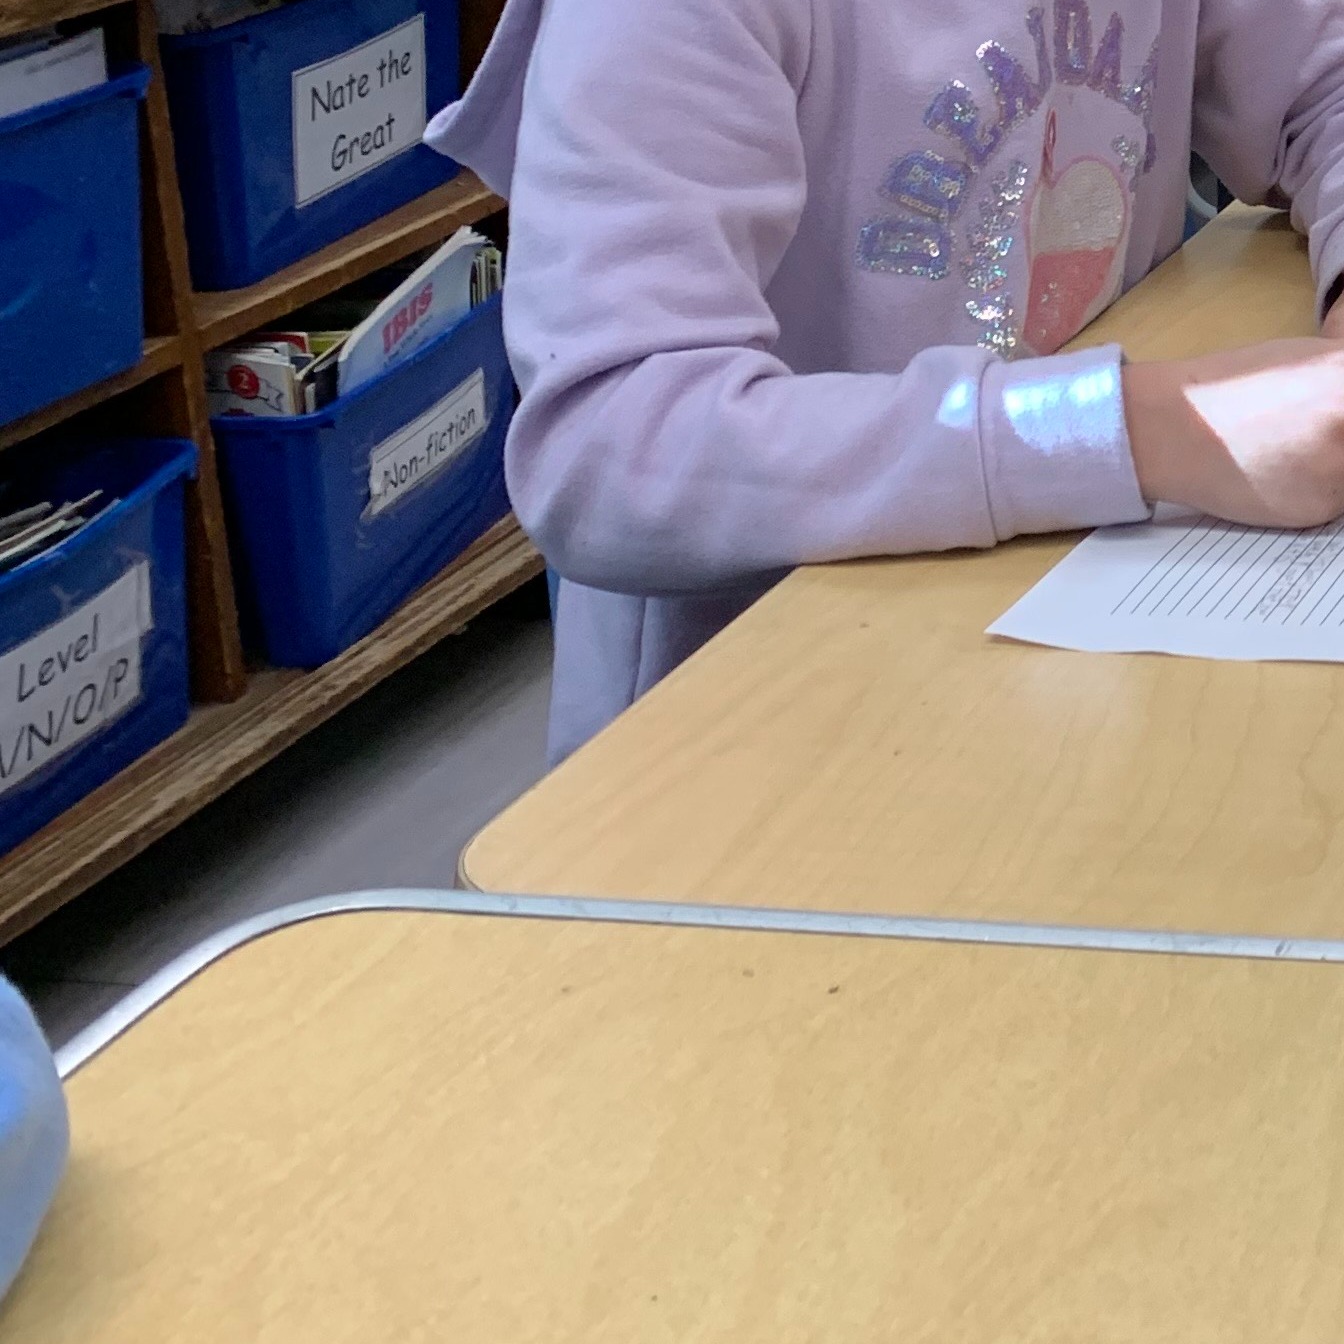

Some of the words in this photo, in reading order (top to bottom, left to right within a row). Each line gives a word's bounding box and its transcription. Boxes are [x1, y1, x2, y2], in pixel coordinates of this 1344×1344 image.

[310, 80, 371, 123] Nate
[375, 49, 412, 89] the
[331, 112, 396, 172] Great
[380, 406, 477, 498] Non-fiction
[16, 612, 100, 704] Level
[0, 657, 129, 779] /N/O/P
